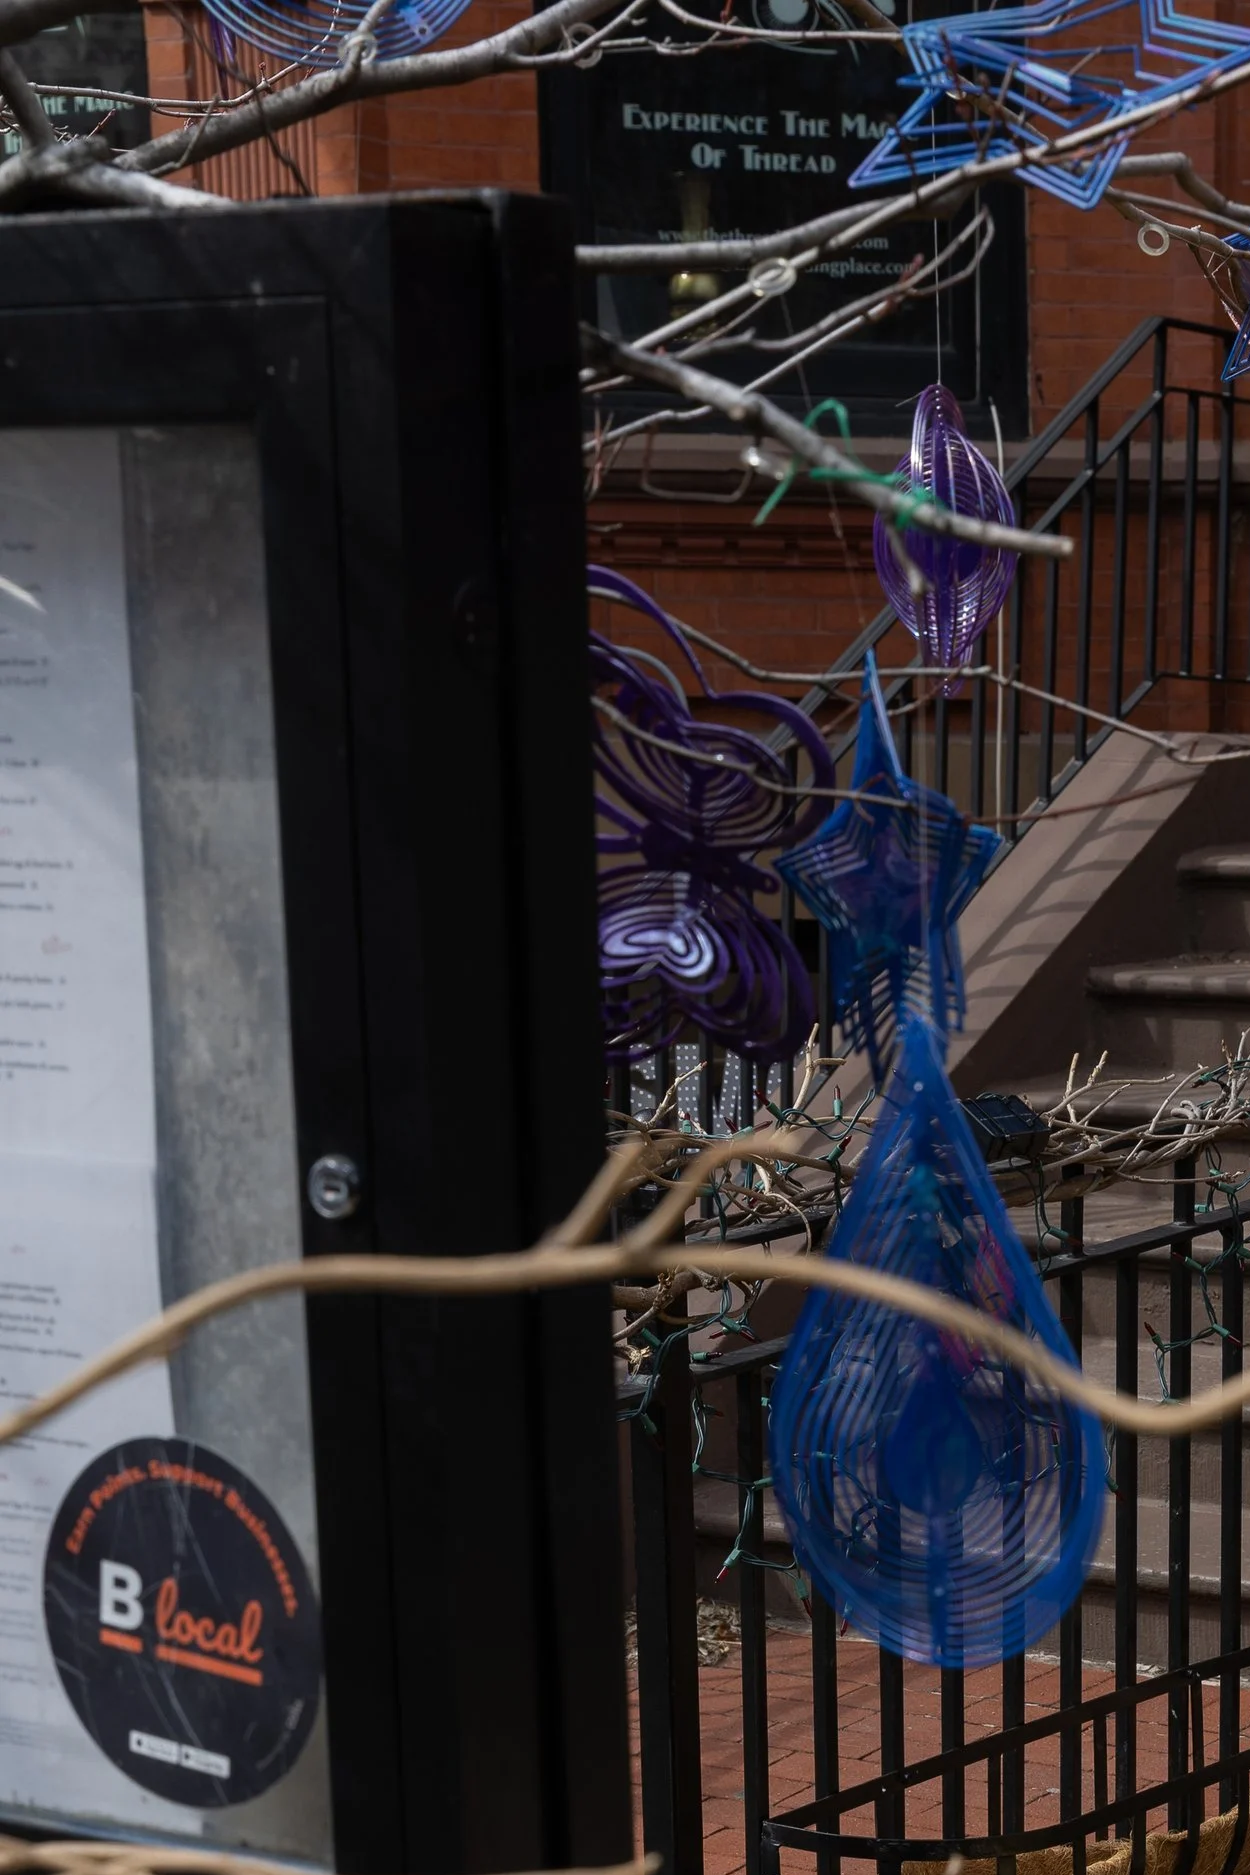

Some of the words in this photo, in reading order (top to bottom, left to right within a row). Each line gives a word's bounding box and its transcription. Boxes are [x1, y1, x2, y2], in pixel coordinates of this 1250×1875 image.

[148, 1459, 224, 1497] Support
[100, 1559, 144, 1630] B
[155, 1577, 264, 1662] local
